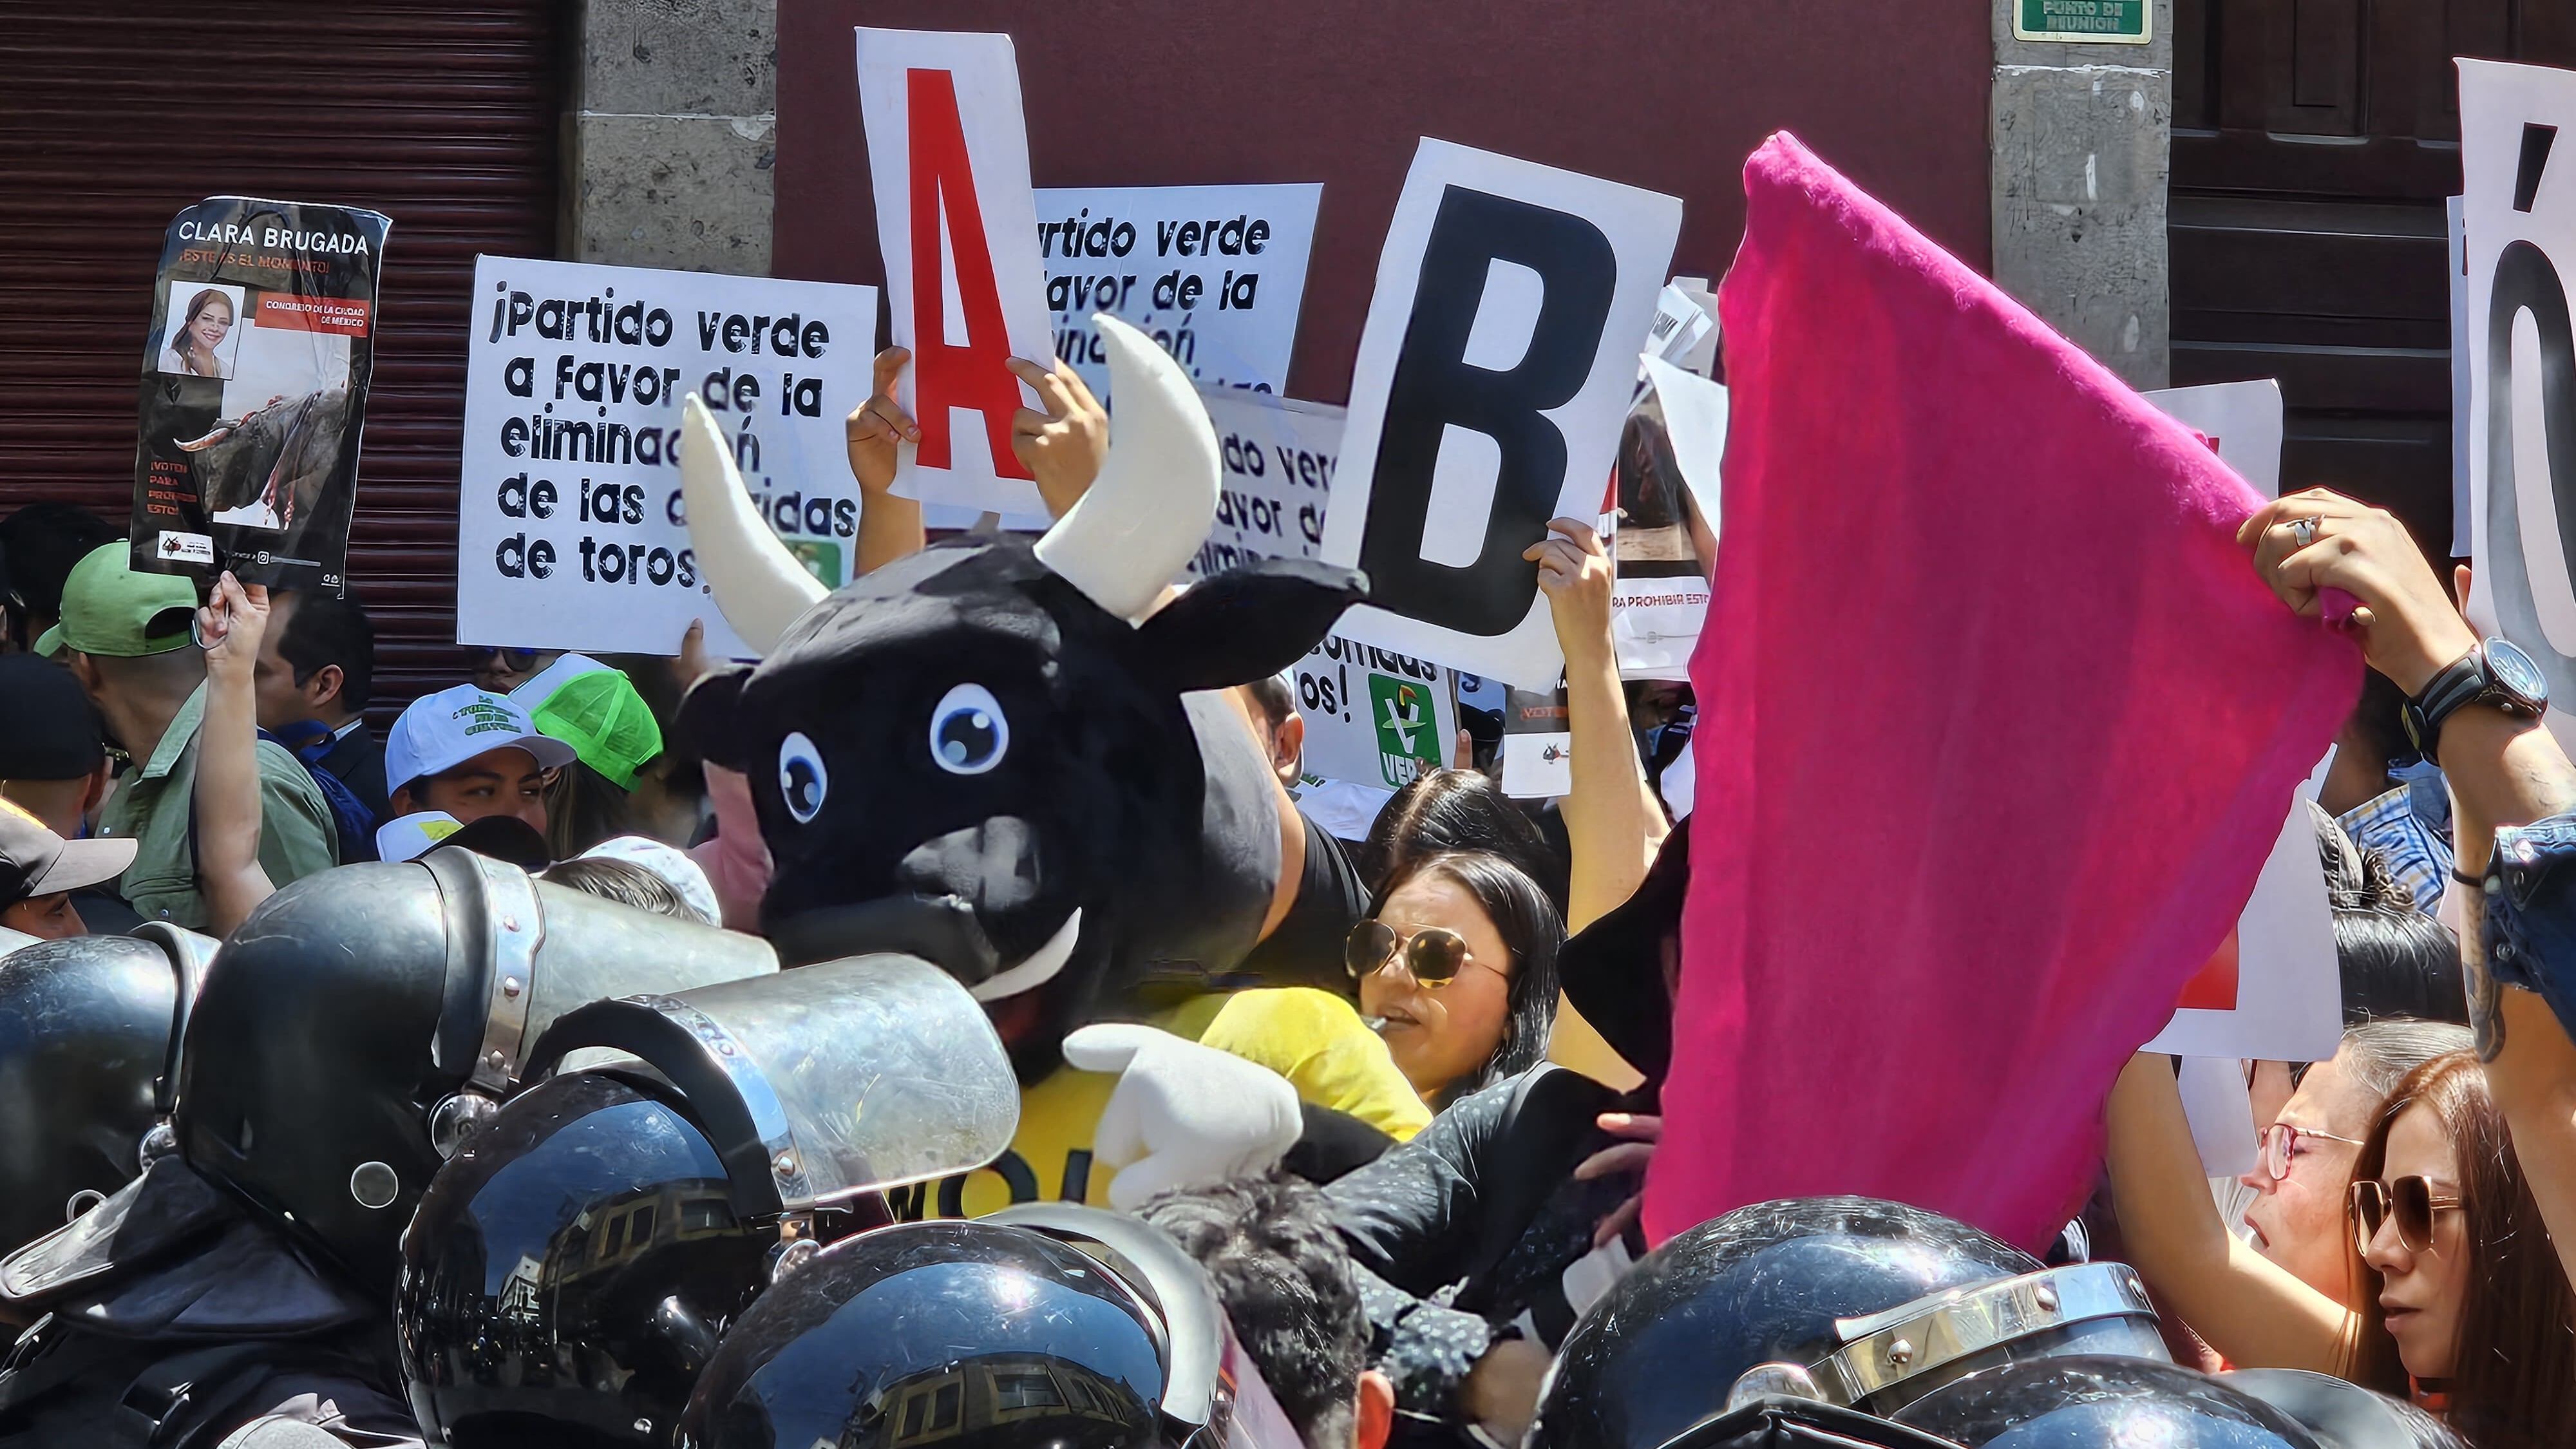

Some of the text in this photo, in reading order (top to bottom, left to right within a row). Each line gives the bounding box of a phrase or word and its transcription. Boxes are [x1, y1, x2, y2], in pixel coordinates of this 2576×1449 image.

[178, 222, 369, 256] CLARA BRUGADA
[1038, 207, 1270, 258] rtido verde
[907, 68, 1037, 482] A
[1044, 269, 1258, 311] avor de la
[697, 312, 830, 359] verde
[504, 355, 823, 418] a favor de la
[1358, 184, 1617, 637] B
[500, 402, 761, 473] eliminacn
[1276, 446, 1337, 492] ver
[497, 473, 558, 520] de
[579, 478, 645, 525] las
[1300, 502, 1325, 545] d
[496, 532, 712, 594] de toros
[1627, 594, 1685, 607] PROHIBIR
[1295, 664, 1351, 723] os!
[1382, 751, 1419, 784] VER
